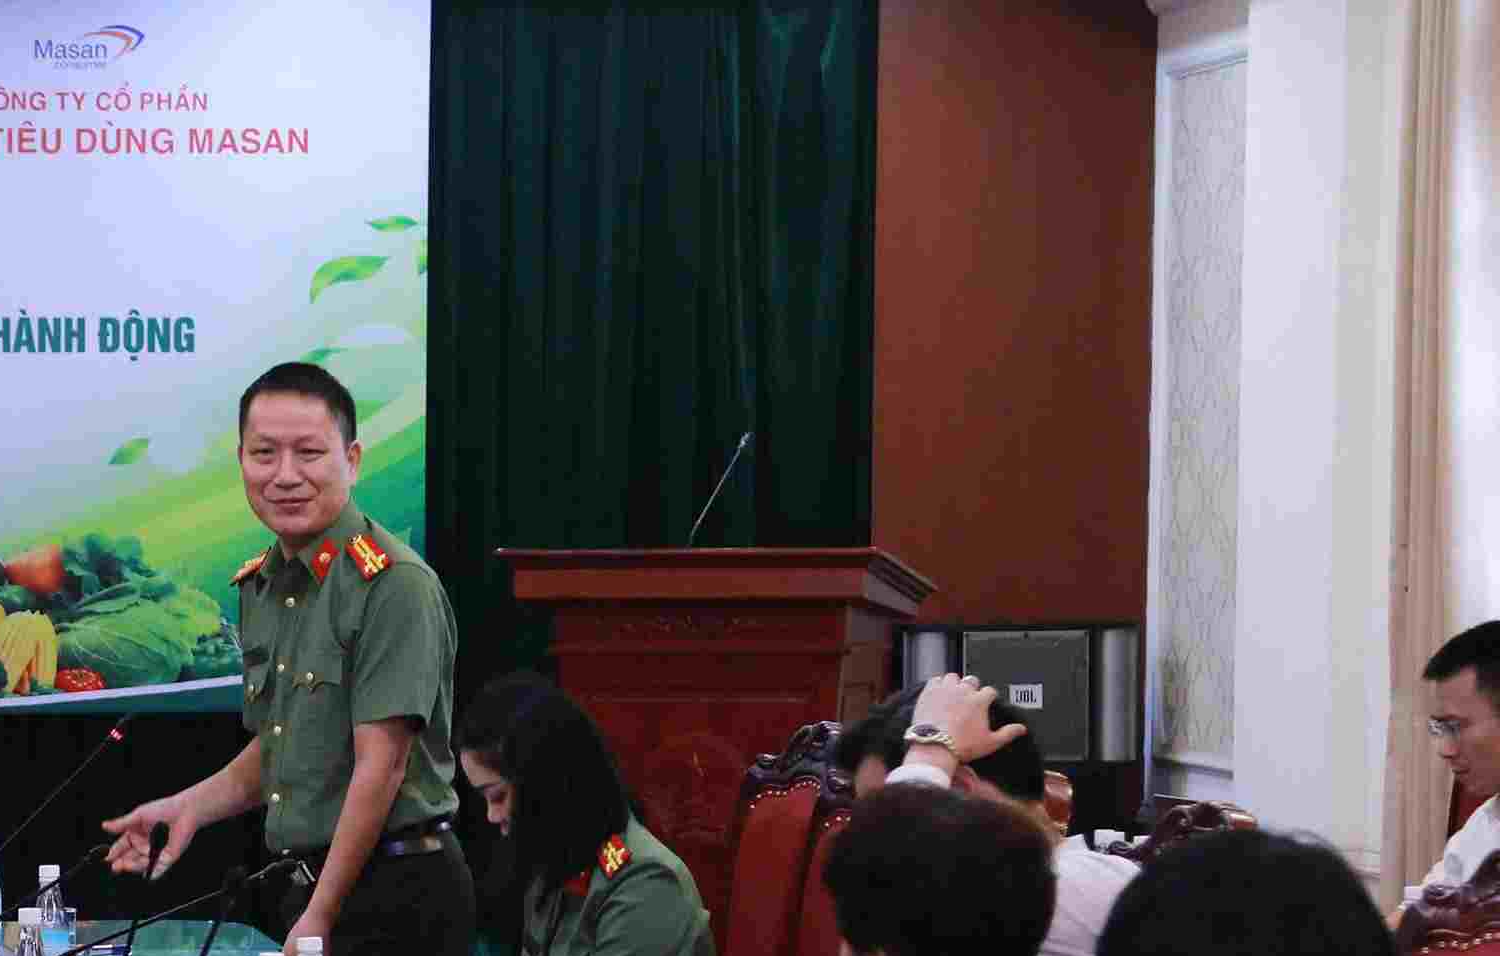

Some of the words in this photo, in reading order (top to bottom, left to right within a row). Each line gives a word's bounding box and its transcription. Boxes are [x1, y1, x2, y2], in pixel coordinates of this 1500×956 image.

[33, 38, 108, 60] Masan
[55, 90, 86, 111] TY
[95, 80, 132, 112] CỔ
[75, 119, 175, 155] DÙNG
[187, 127, 310, 154] MASAN
[98, 309, 197, 362] ĐỘNG
